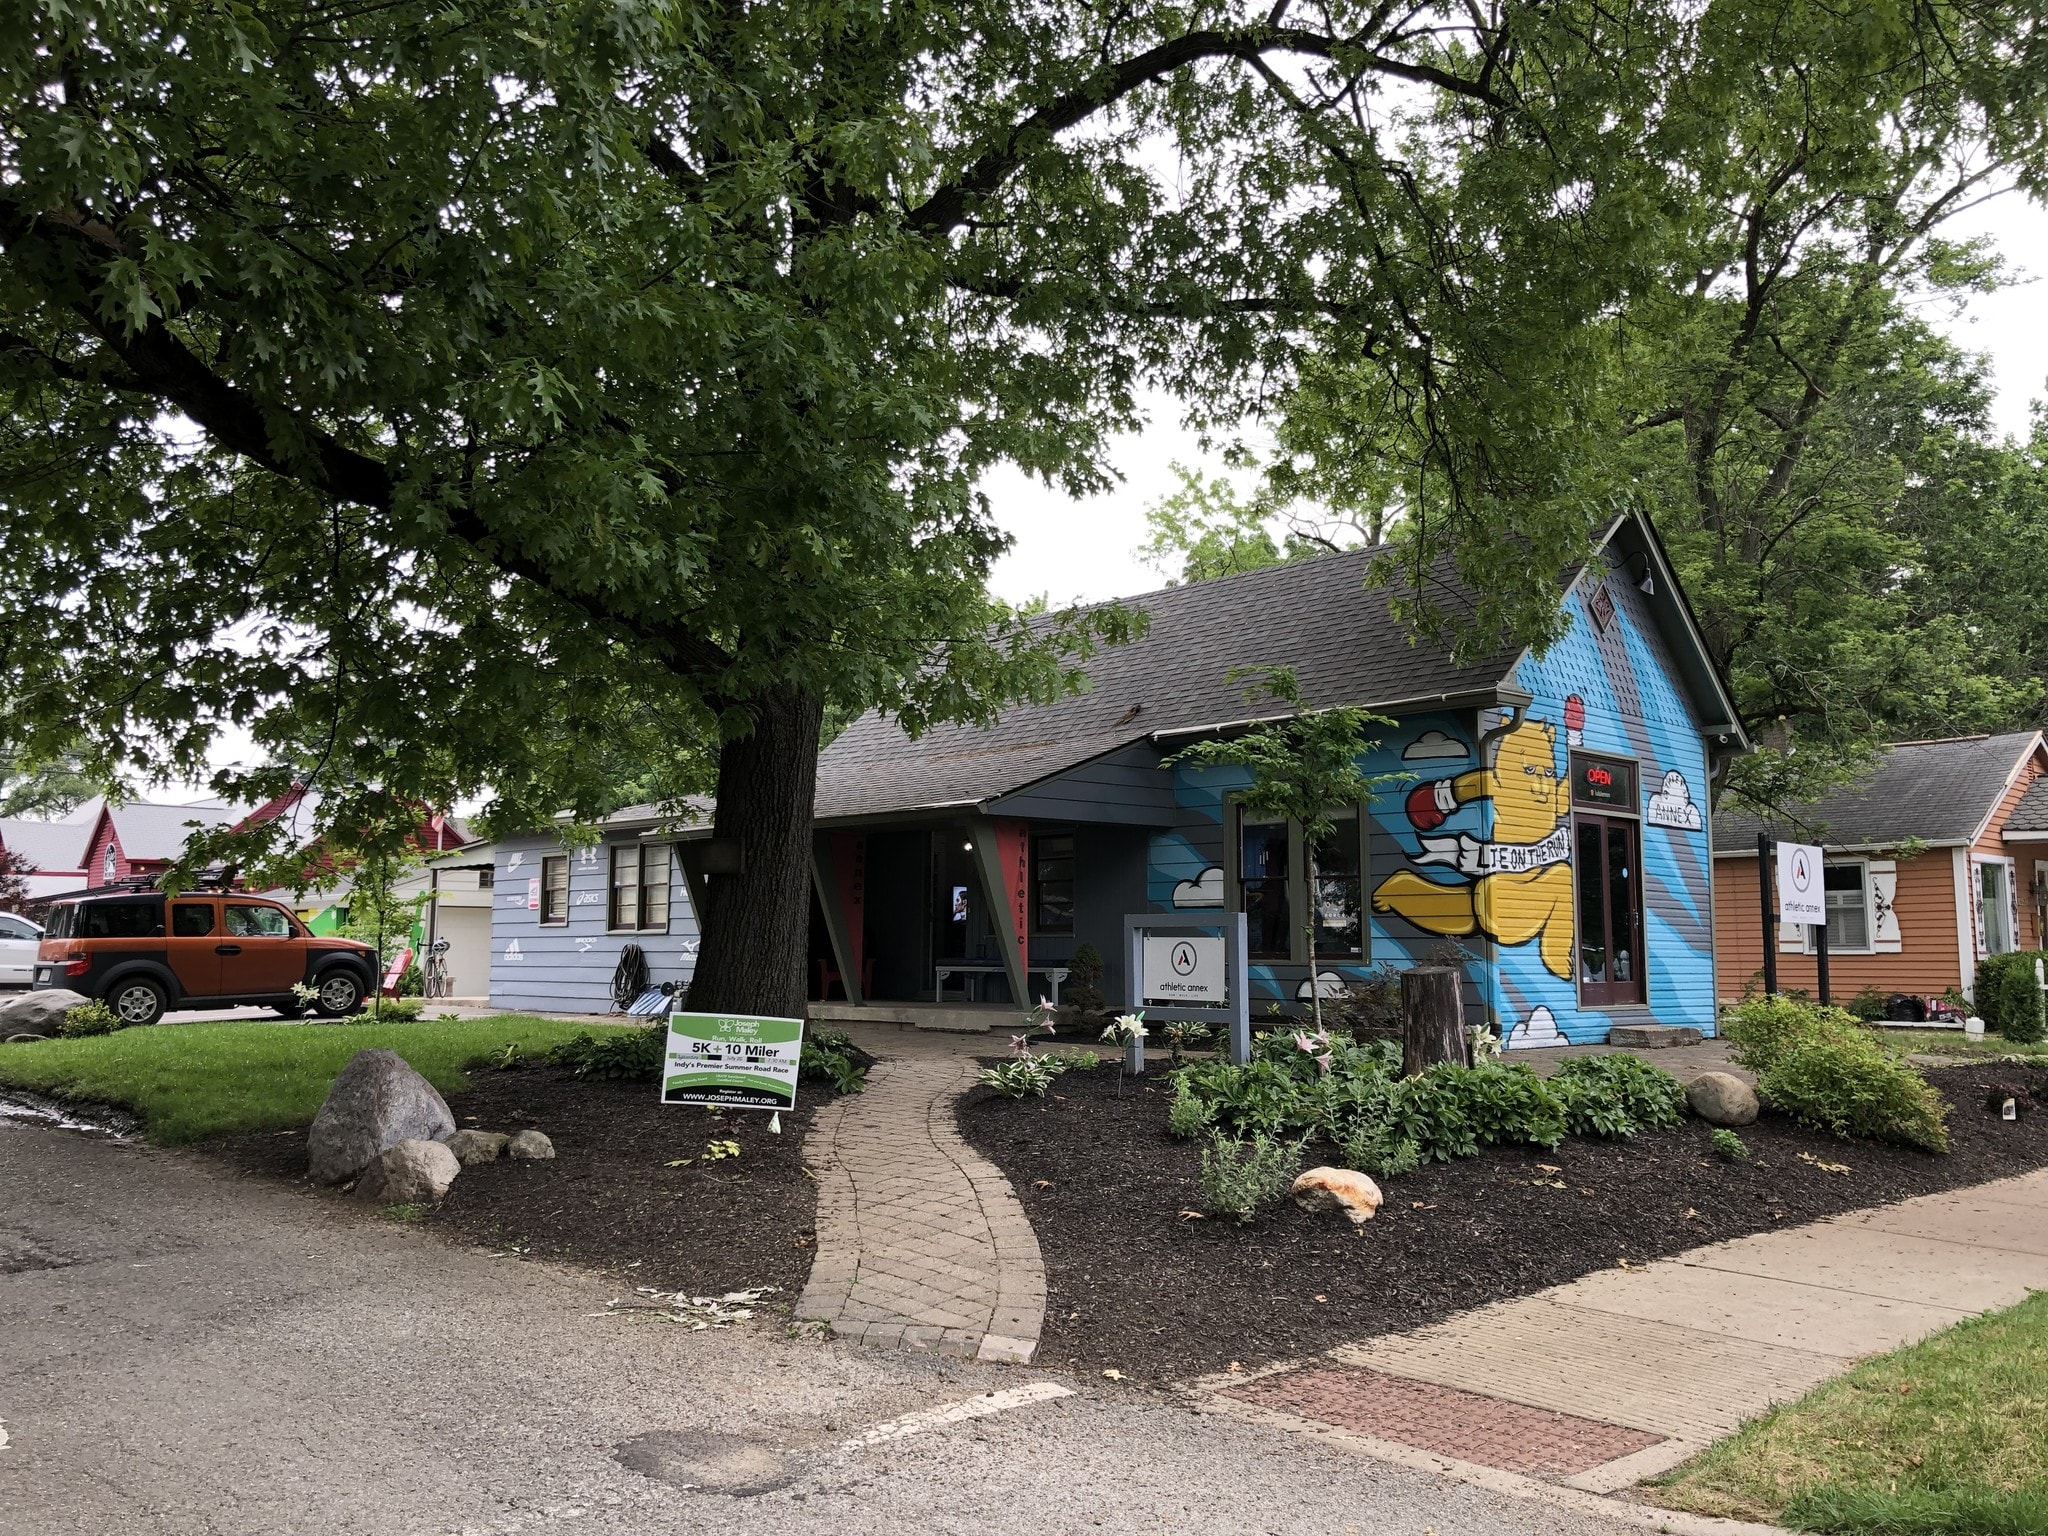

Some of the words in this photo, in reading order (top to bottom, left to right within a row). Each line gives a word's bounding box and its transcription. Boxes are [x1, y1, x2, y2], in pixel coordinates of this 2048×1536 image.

[1588, 768, 1612, 785] OPEN
[1655, 803, 1692, 826] ANNEX
[853, 841, 864, 904] annex
[1017, 828, 1026, 945] athletic
[1784, 900, 1805, 912] athletic
[1806, 904, 1821, 913] annex
[1160, 982, 1186, 992] athletic
[1188, 984, 1208, 992] annex
[734, 1020, 760, 1028] Joseph
[736, 1026, 759, 1036] Maley
[692, 1042, 711, 1054] 5K
[713, 1045, 722, 1054] +
[725, 1044, 742, 1055] 10
[745, 1045, 780, 1058] Miler
[674, 1061, 695, 1070] Indy's
[696, 1062, 722, 1070] Premier
[724, 1064, 752, 1072] Summer
[772, 1066, 789, 1074] Race
[683, 1093, 778, 1105] WWW.JOSEPHMALEY.ORG
